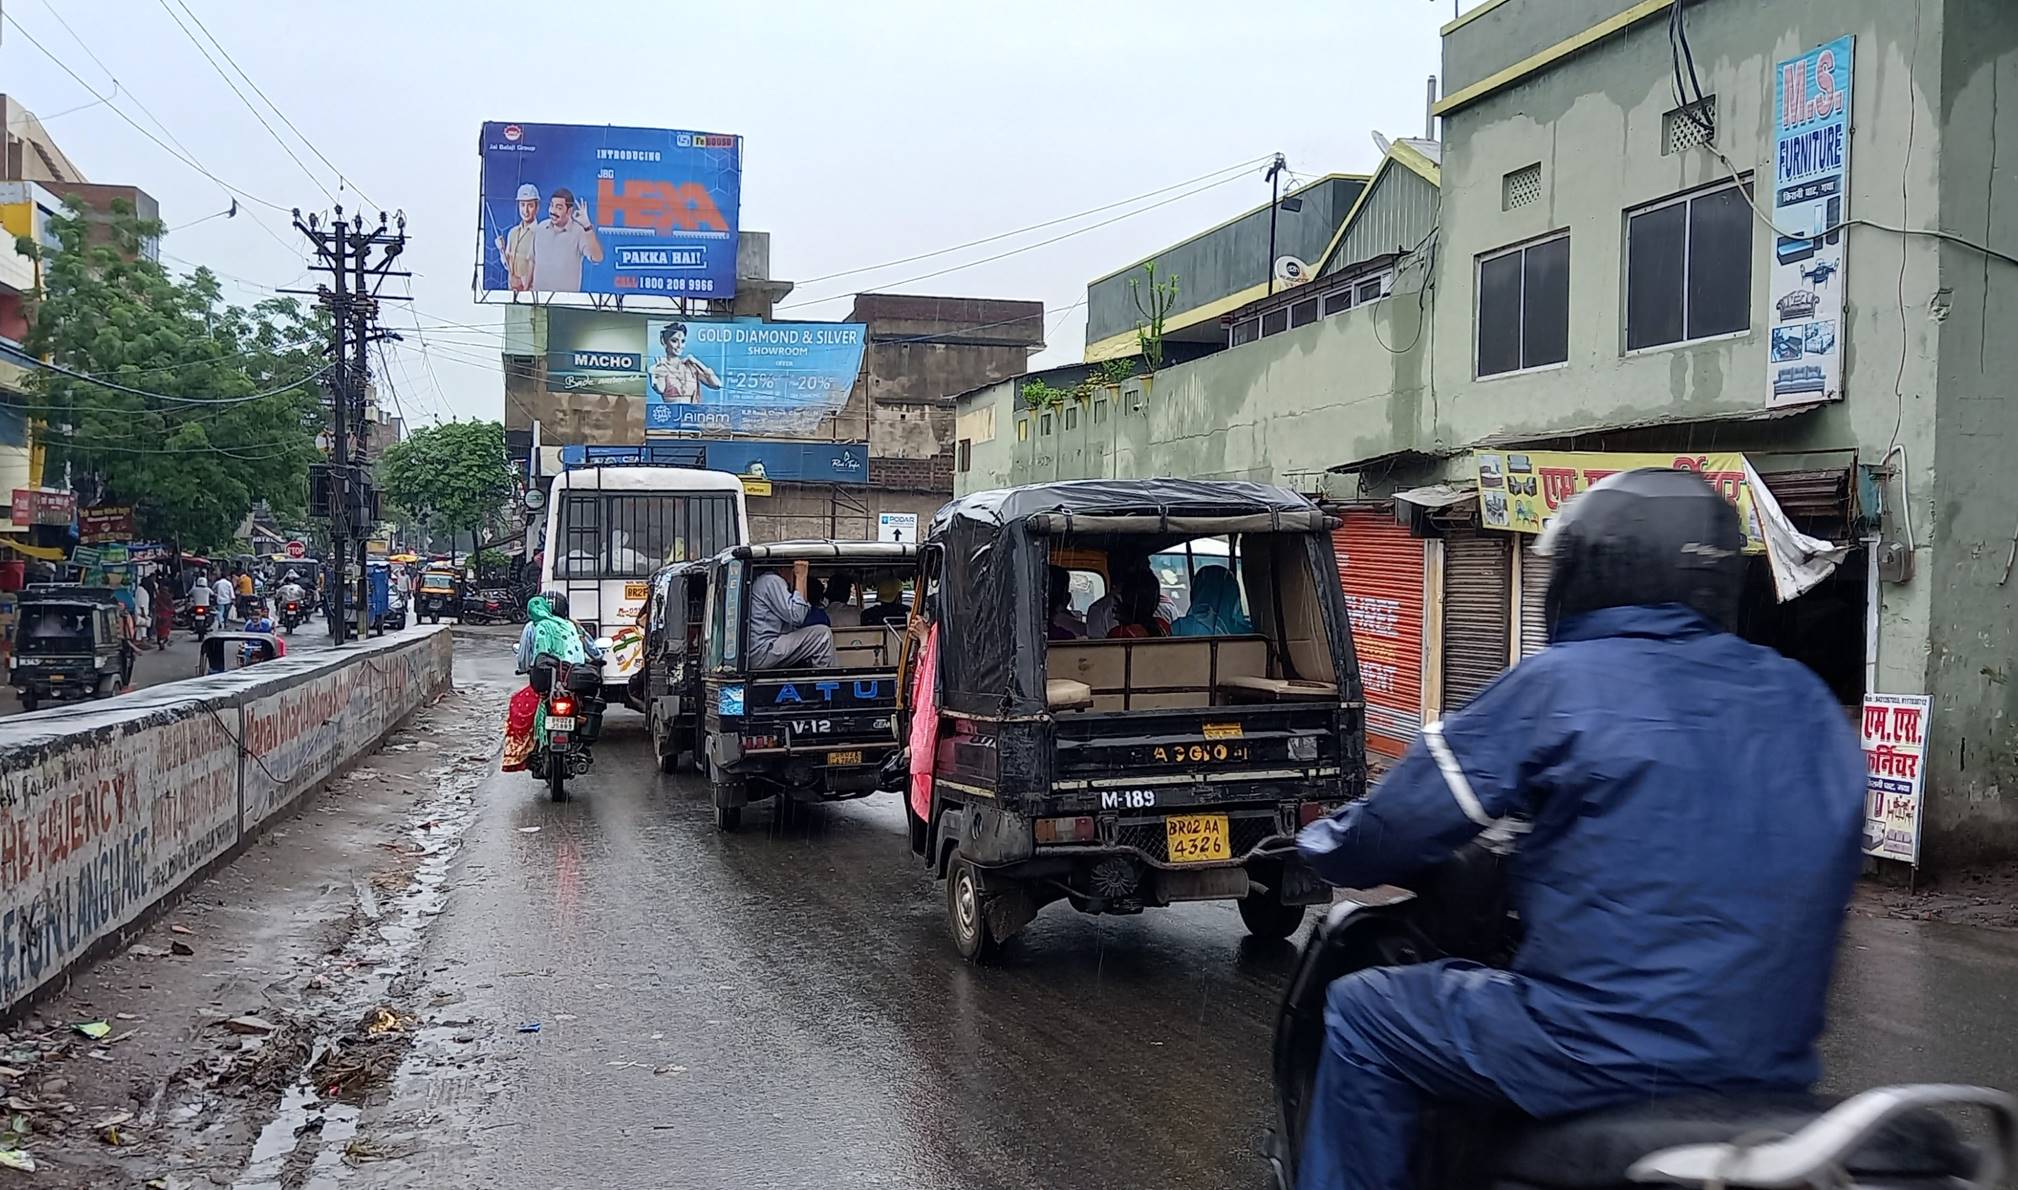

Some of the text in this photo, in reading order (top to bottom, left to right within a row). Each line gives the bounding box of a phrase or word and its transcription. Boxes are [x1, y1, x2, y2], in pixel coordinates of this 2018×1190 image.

[1782, 50, 1843, 129] M.S.
[597, 149, 661, 161] INTRODUCING
[1779, 124, 1842, 180] FURNITURE
[622, 251, 701, 264] PAKKA HAI!
[640, 277, 664, 290] 1800
[666, 279, 685, 290] 208
[688, 280, 713, 291] 9966
[698, 328, 857, 344] GOLD DIAMOND & SILVER
[748, 347, 807, 356] SHOWROOM
[574, 354, 632, 368] MACHO
[287, 547, 304, 555] STOP
[774, 680, 897, 703] ATU
[792, 719, 831, 734] V-12
[1101, 790, 1155, 809] M-189
[1169, 819, 1219, 836] BR02 AA
[1175, 837, 1221, 854] 4326
